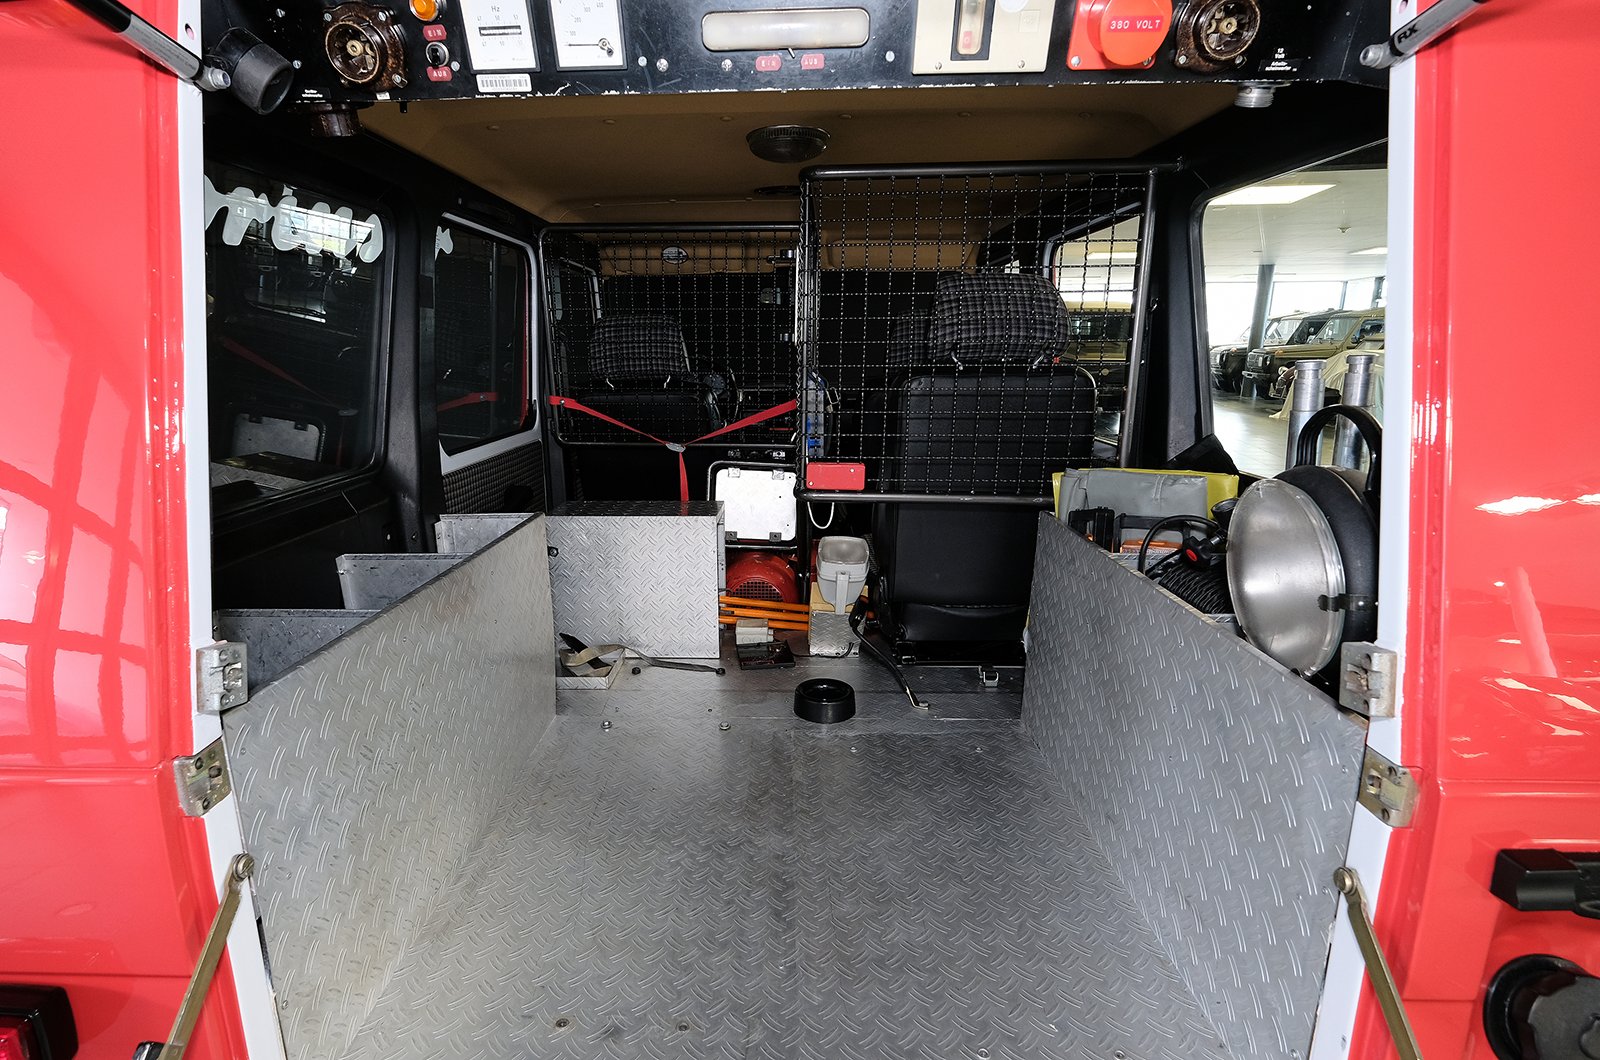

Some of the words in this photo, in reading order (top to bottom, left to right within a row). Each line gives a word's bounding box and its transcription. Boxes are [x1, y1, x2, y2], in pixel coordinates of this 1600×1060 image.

[1110, 20, 1130, 30] 380
[1136, 19, 1161, 29] VOLT
[427, 29, 443, 37] EIN
